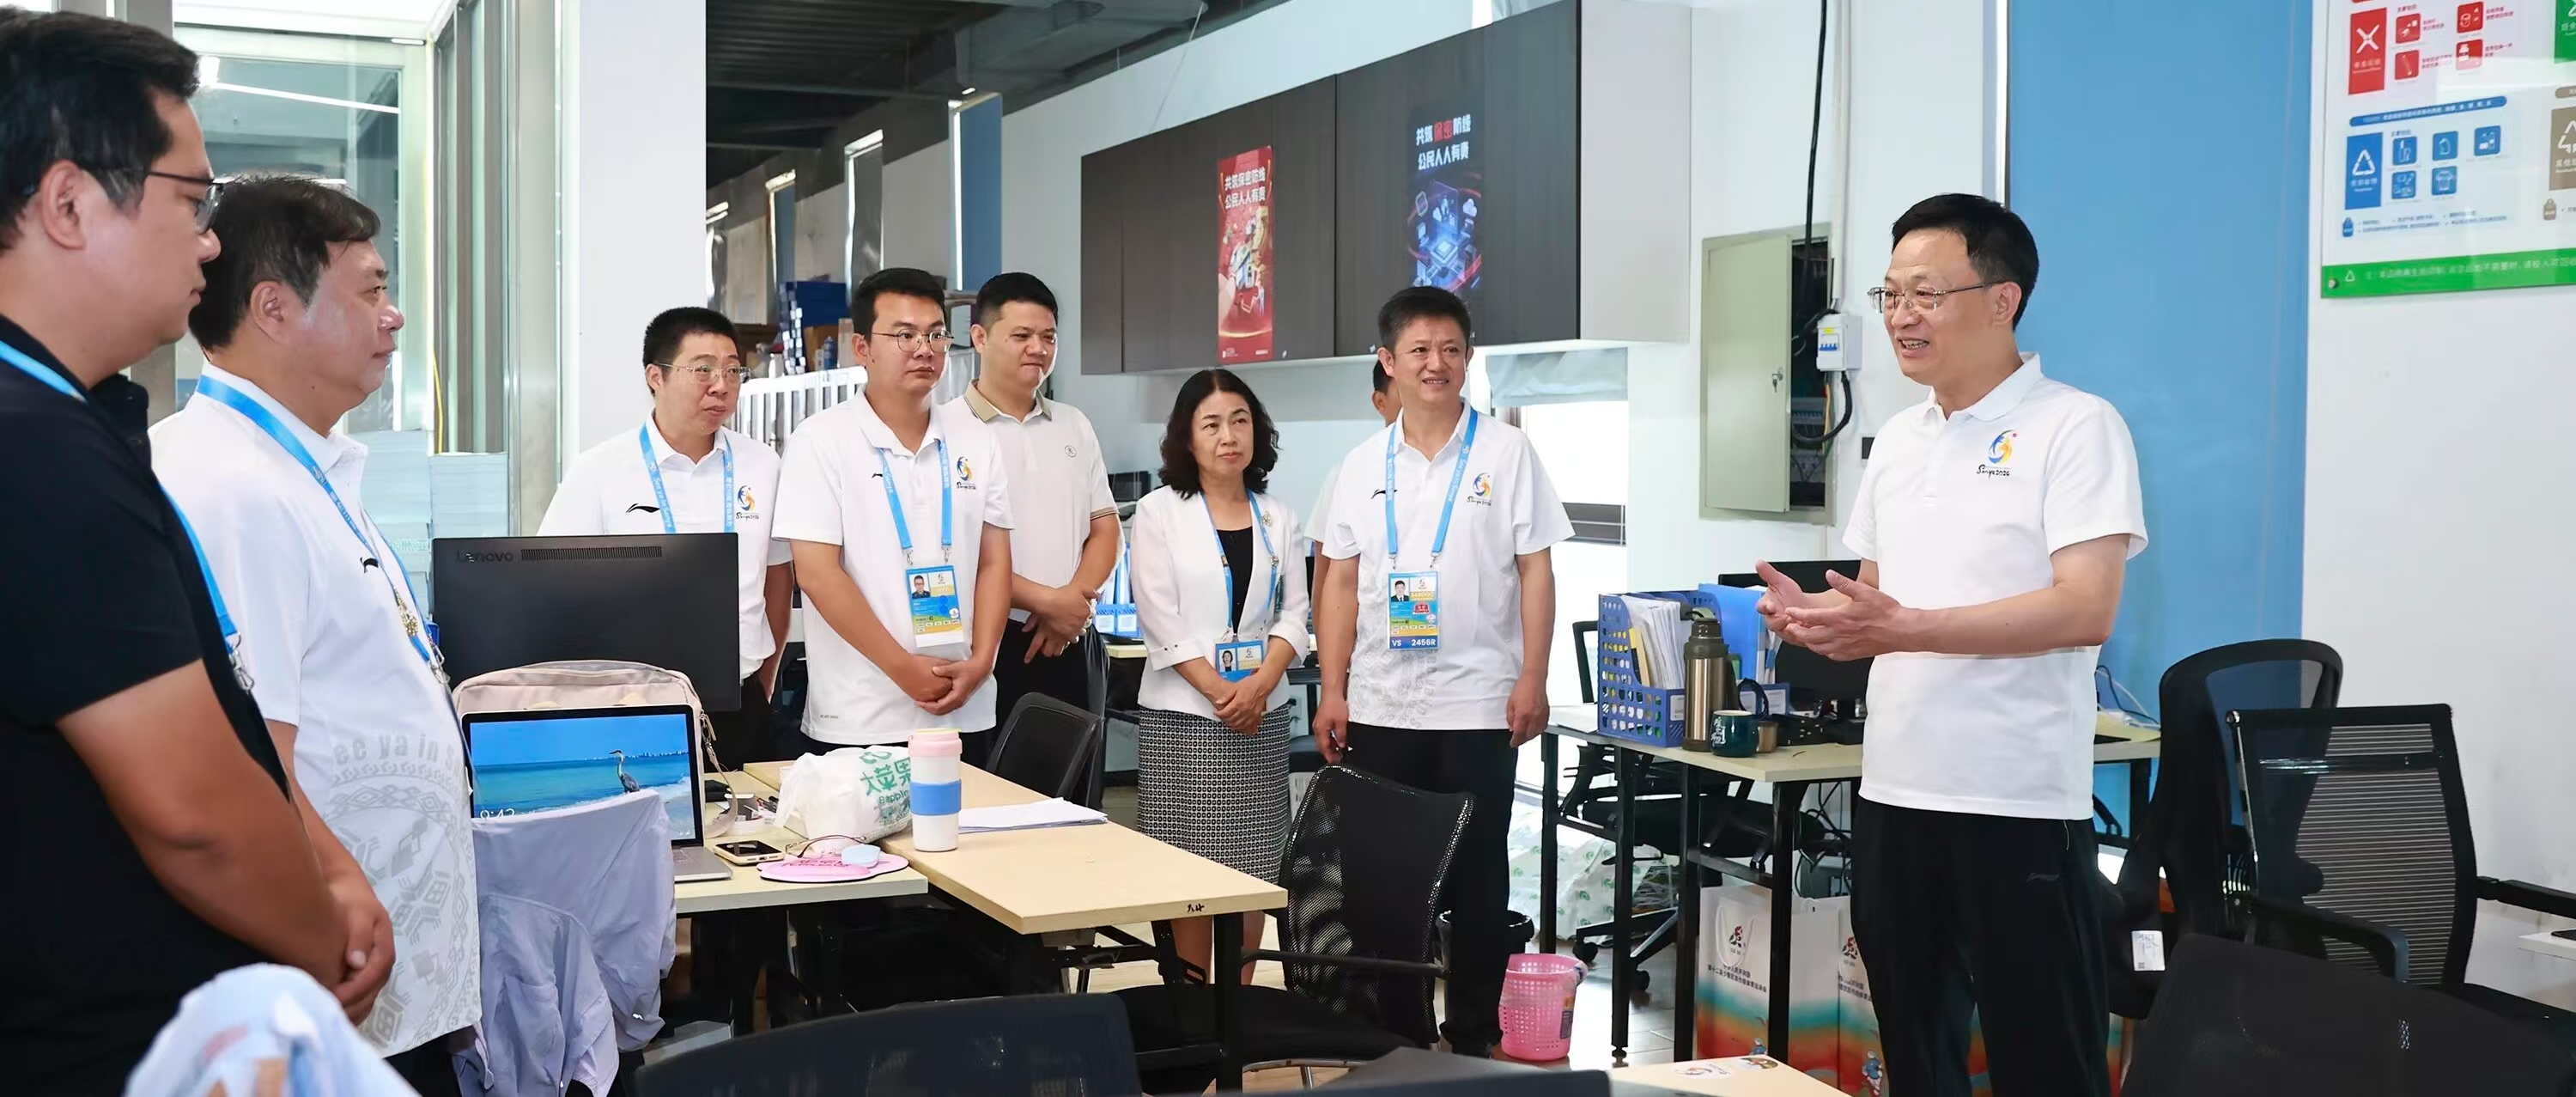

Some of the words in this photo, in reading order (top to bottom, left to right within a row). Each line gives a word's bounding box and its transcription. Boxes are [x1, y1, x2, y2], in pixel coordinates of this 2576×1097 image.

[1416, 113, 1472, 146] 共筑保密防线
[1418, 141, 1469, 171] 公民人人有责
[1224, 167, 1266, 192] 共筑保密防线
[1224, 186, 1266, 210] 公民人人有责
